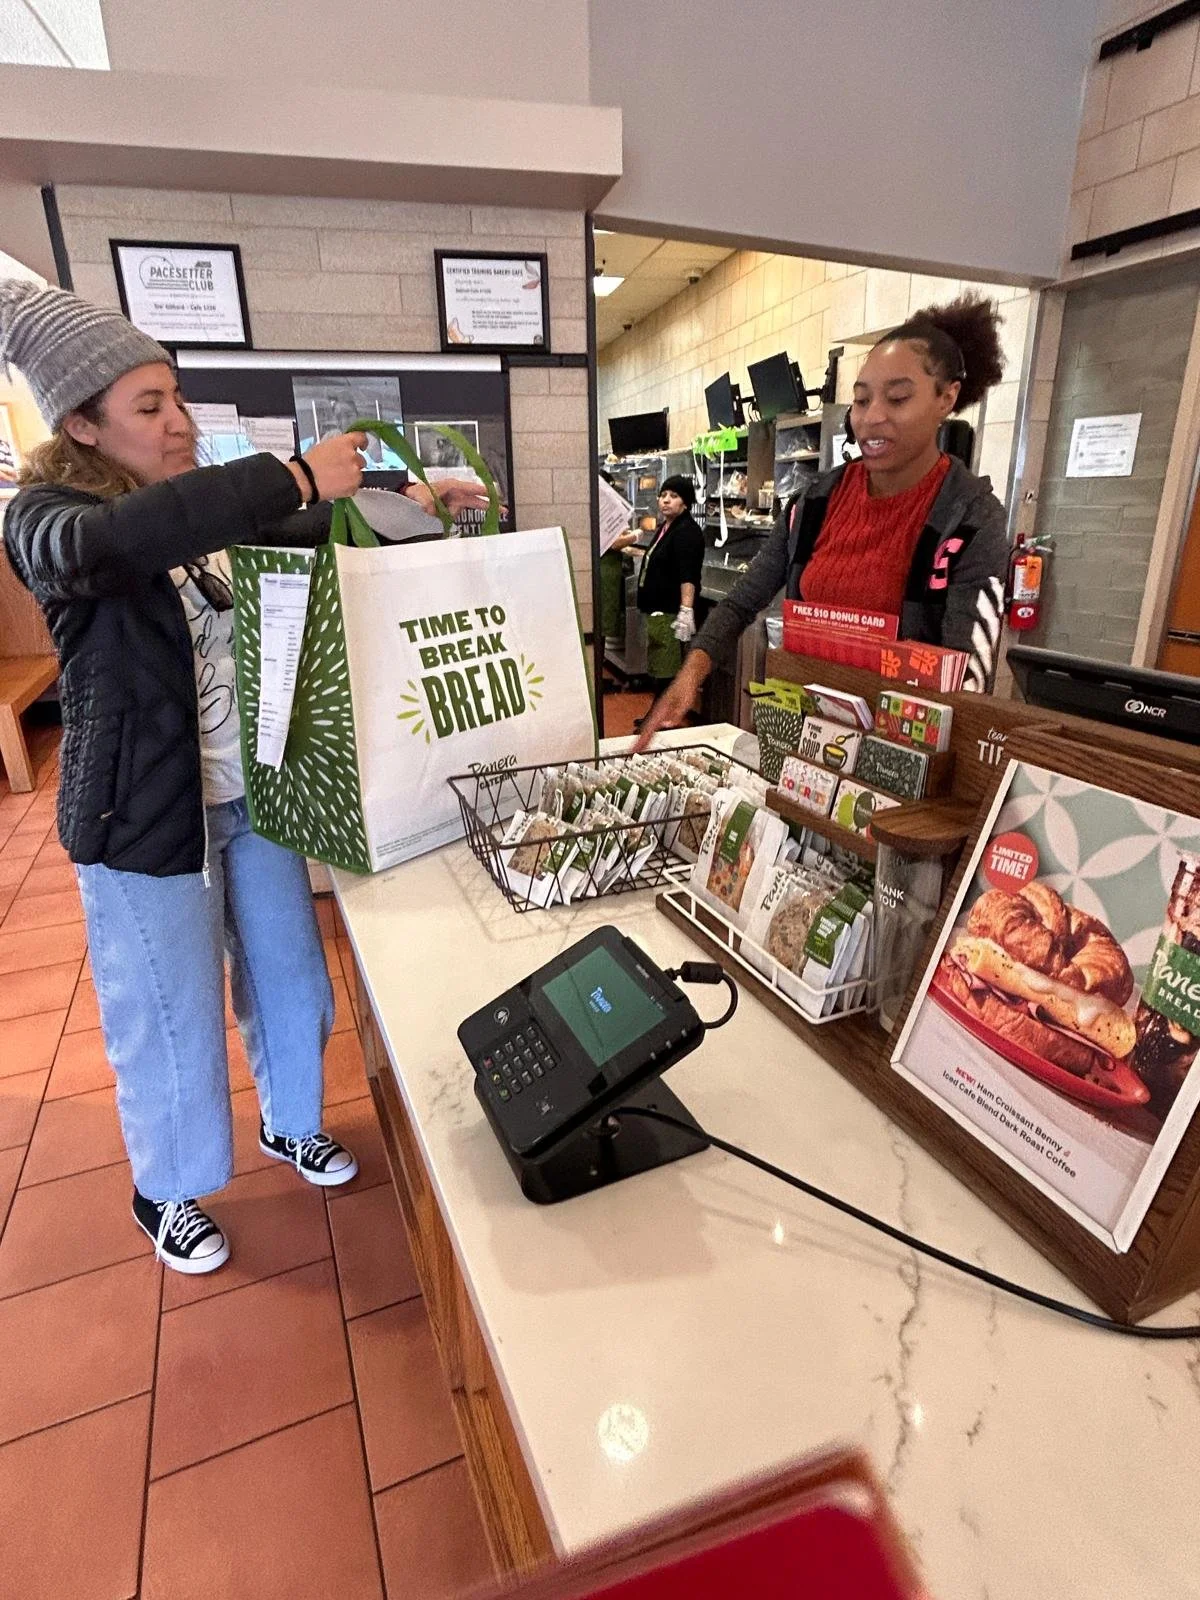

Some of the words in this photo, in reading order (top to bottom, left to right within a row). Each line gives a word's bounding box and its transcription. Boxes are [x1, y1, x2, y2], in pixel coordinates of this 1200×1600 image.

[150, 266, 213, 280] PACESETTER
[188, 280, 214, 291] CLUB
[399, 610, 473, 643] TIME
[475, 604, 506, 628] TO
[792, 605, 813, 615] FREE
[813, 607, 829, 619] $10
[830, 610, 860, 624] BONUS
[861, 615, 885, 628] CARD
[419, 632, 508, 669] BREAK
[421, 658, 526, 738] BREAD
[1143, 705, 1167, 718] NCR
[807, 722, 822, 733] TIME
[809, 731, 818, 740] TO
[766, 733, 793, 751] Panera
[800, 737, 821, 759] SOUP
[468, 754, 518, 780] Panera
[992, 844, 1034, 864] LIMITED
[990, 854, 1030, 880] TIME!
[877, 883, 905, 901] HANK
[955, 1067, 977, 1086] NEW!
[976, 1082, 995, 1099] Ham
[995, 1096, 1035, 1130] Croissant
[1034, 1126, 1063, 1152] Benny
[942, 1070, 959, 1087] Iced
[958, 1081, 976, 1100] Cafe
[976, 1095, 1000, 1118] Blend
[998, 1114, 1020, 1134] Dark
[1019, 1130, 1045, 1154] Roast
[1045, 1150, 1077, 1178] Coffee
